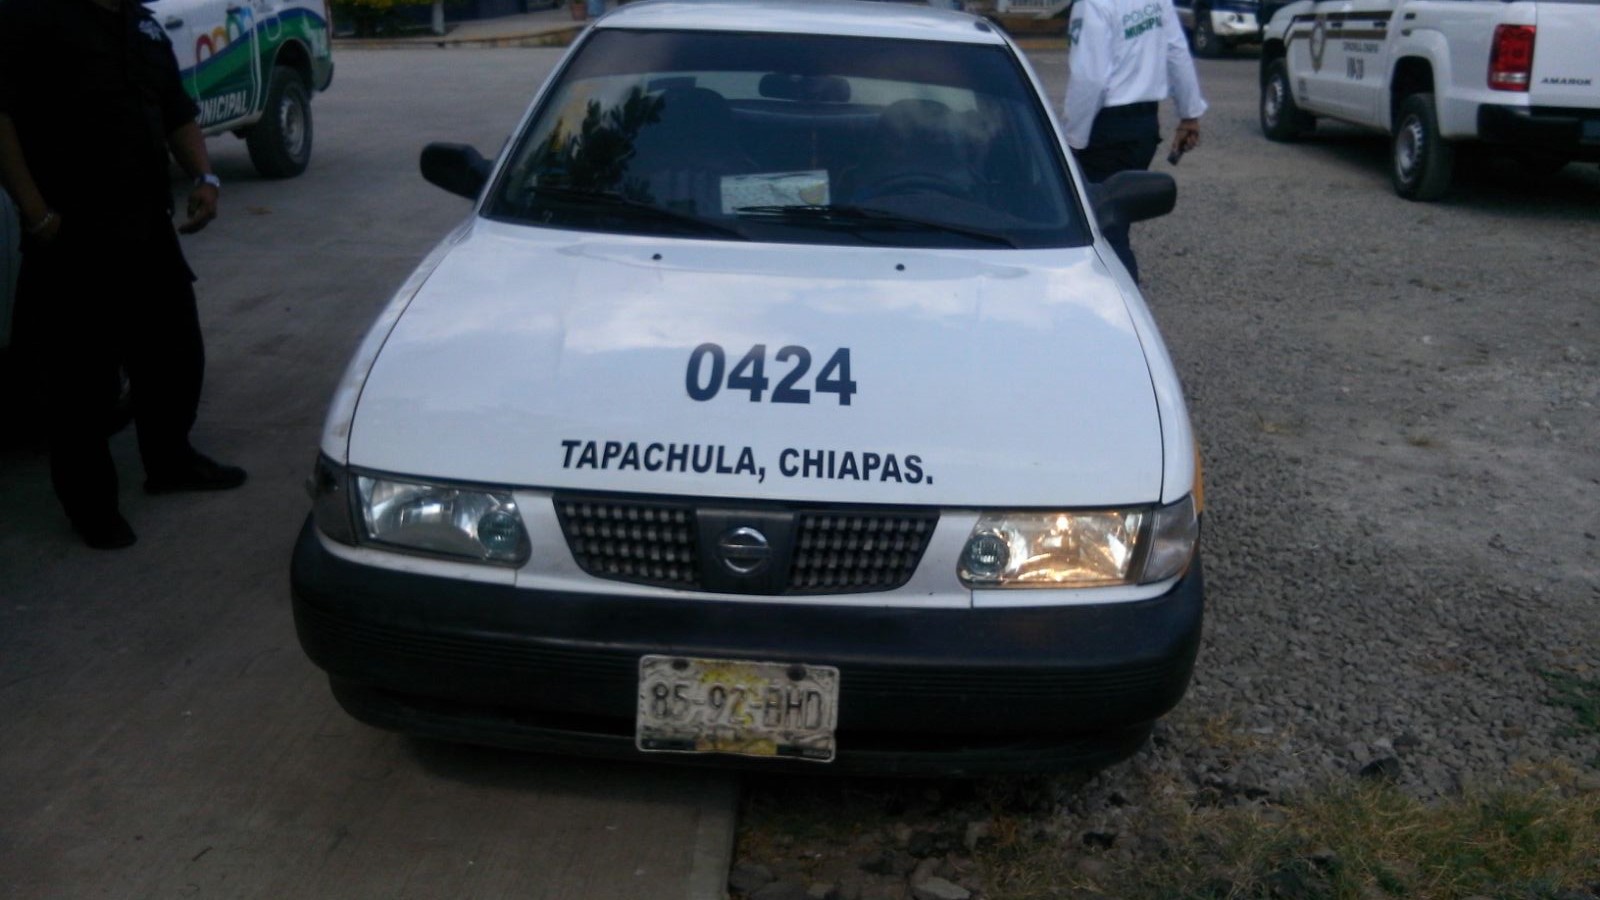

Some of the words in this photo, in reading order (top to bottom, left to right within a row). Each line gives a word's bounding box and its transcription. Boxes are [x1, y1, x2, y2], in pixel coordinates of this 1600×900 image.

[1540, 77, 1592, 86] AMAROK
[685, 342, 857, 406] 0424
[561, 439, 766, 484] TAPACHULA,
[778, 447, 934, 486] CHIAPAS.
